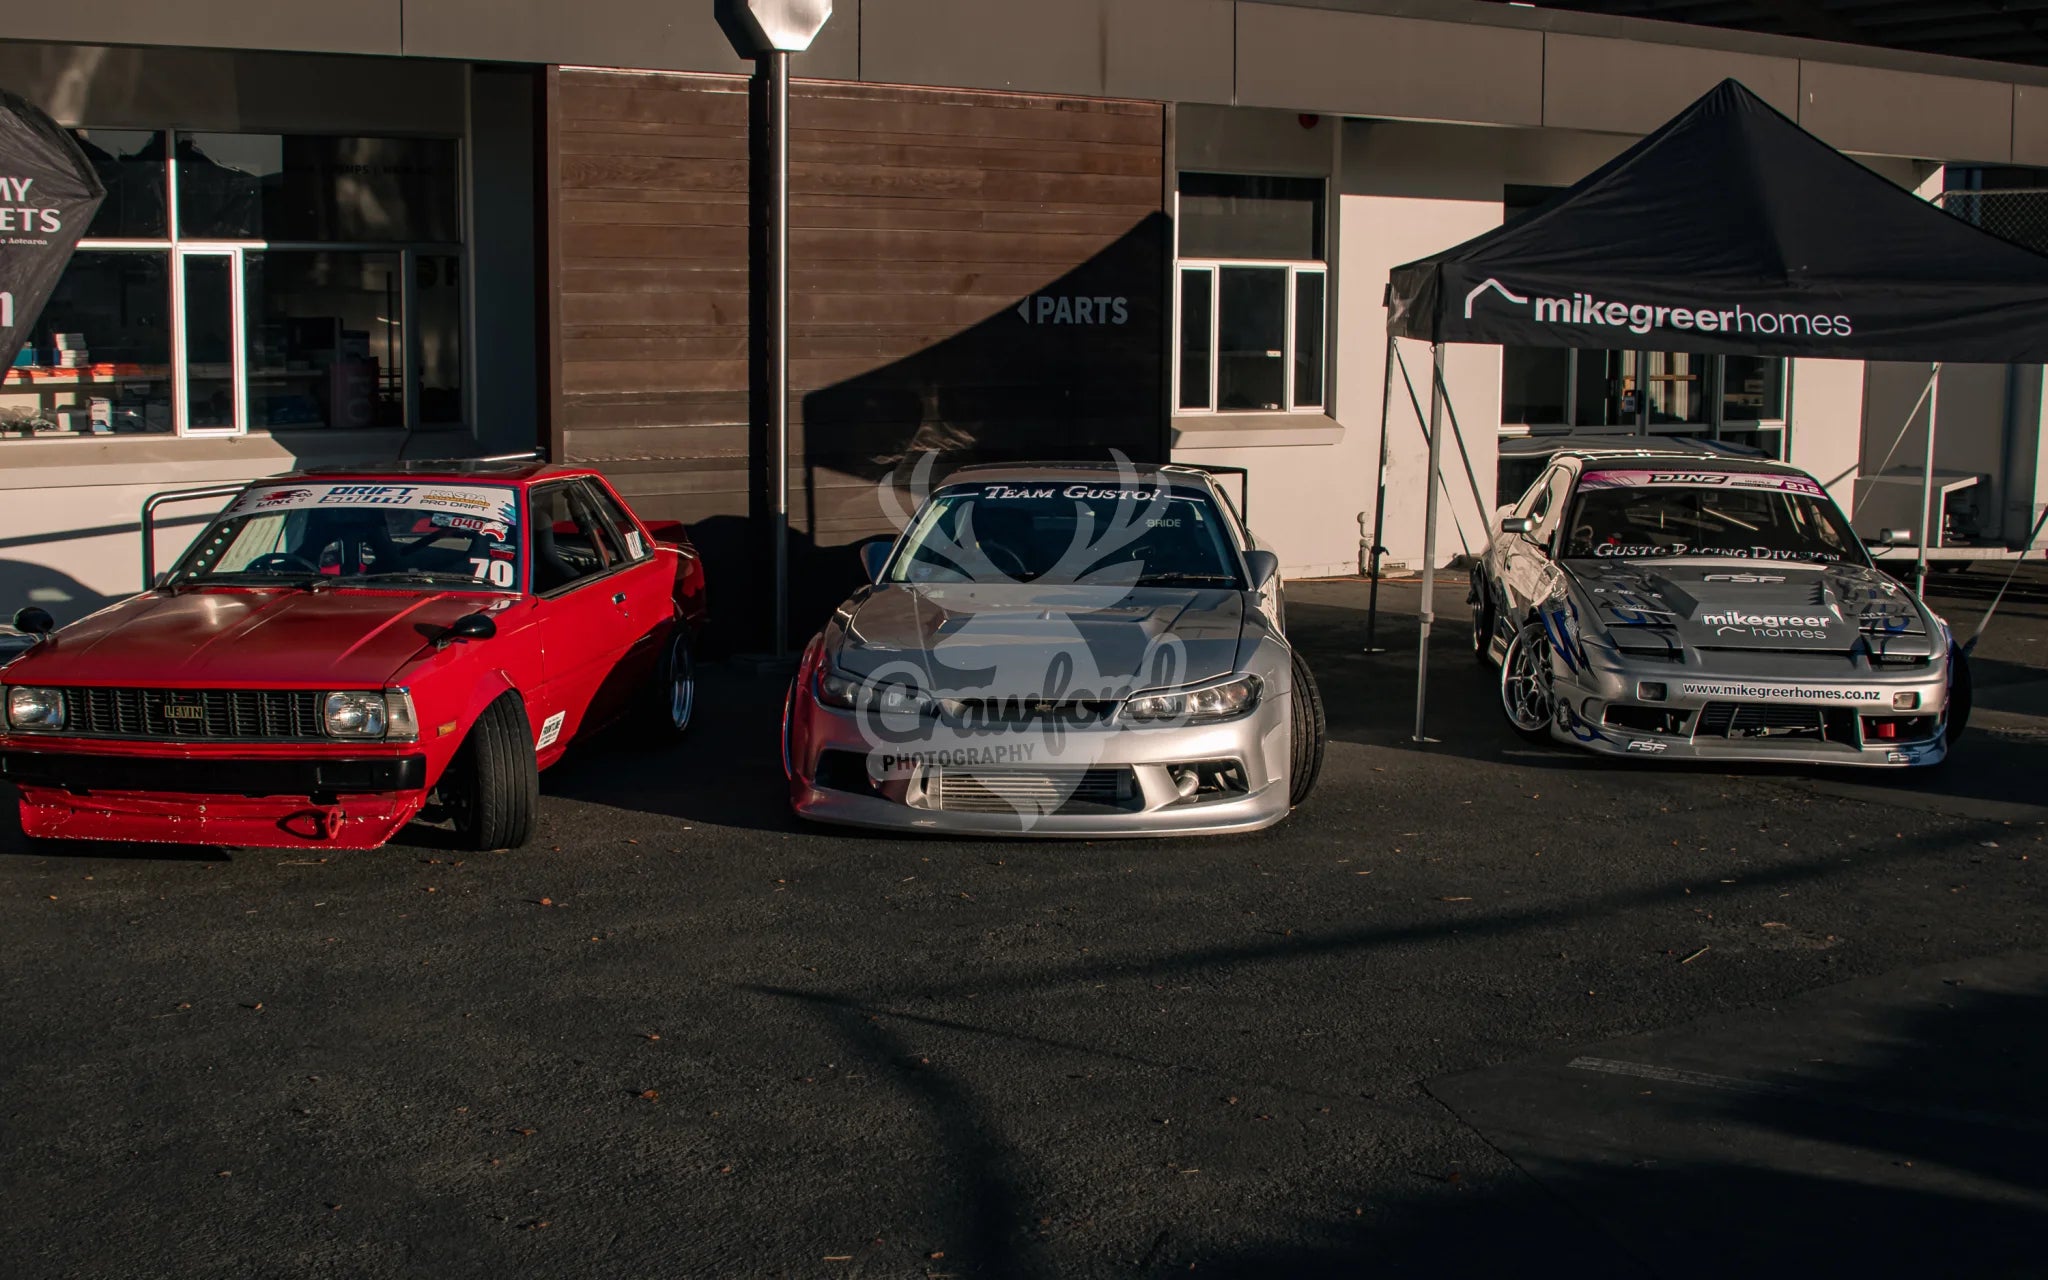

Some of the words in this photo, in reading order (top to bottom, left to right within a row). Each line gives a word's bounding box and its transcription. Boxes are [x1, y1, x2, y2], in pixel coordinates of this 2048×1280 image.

[0, 207, 62, 233] ETS
[1036, 295, 1129, 325] PARTS
[1534, 293, 1852, 336] mikegreerhomes
[327, 486, 419, 495] DRIFT
[1785, 482, 1821, 494] 212
[450, 501, 489, 511] DRIFT
[1146, 518, 1182, 528] BRIDE
[469, 557, 514, 588] 70
[1702, 611, 1830, 628] mikegreer
[1751, 626, 1827, 640] homes
[1683, 683, 1881, 700] www.mikegreerhomes.co.nz
